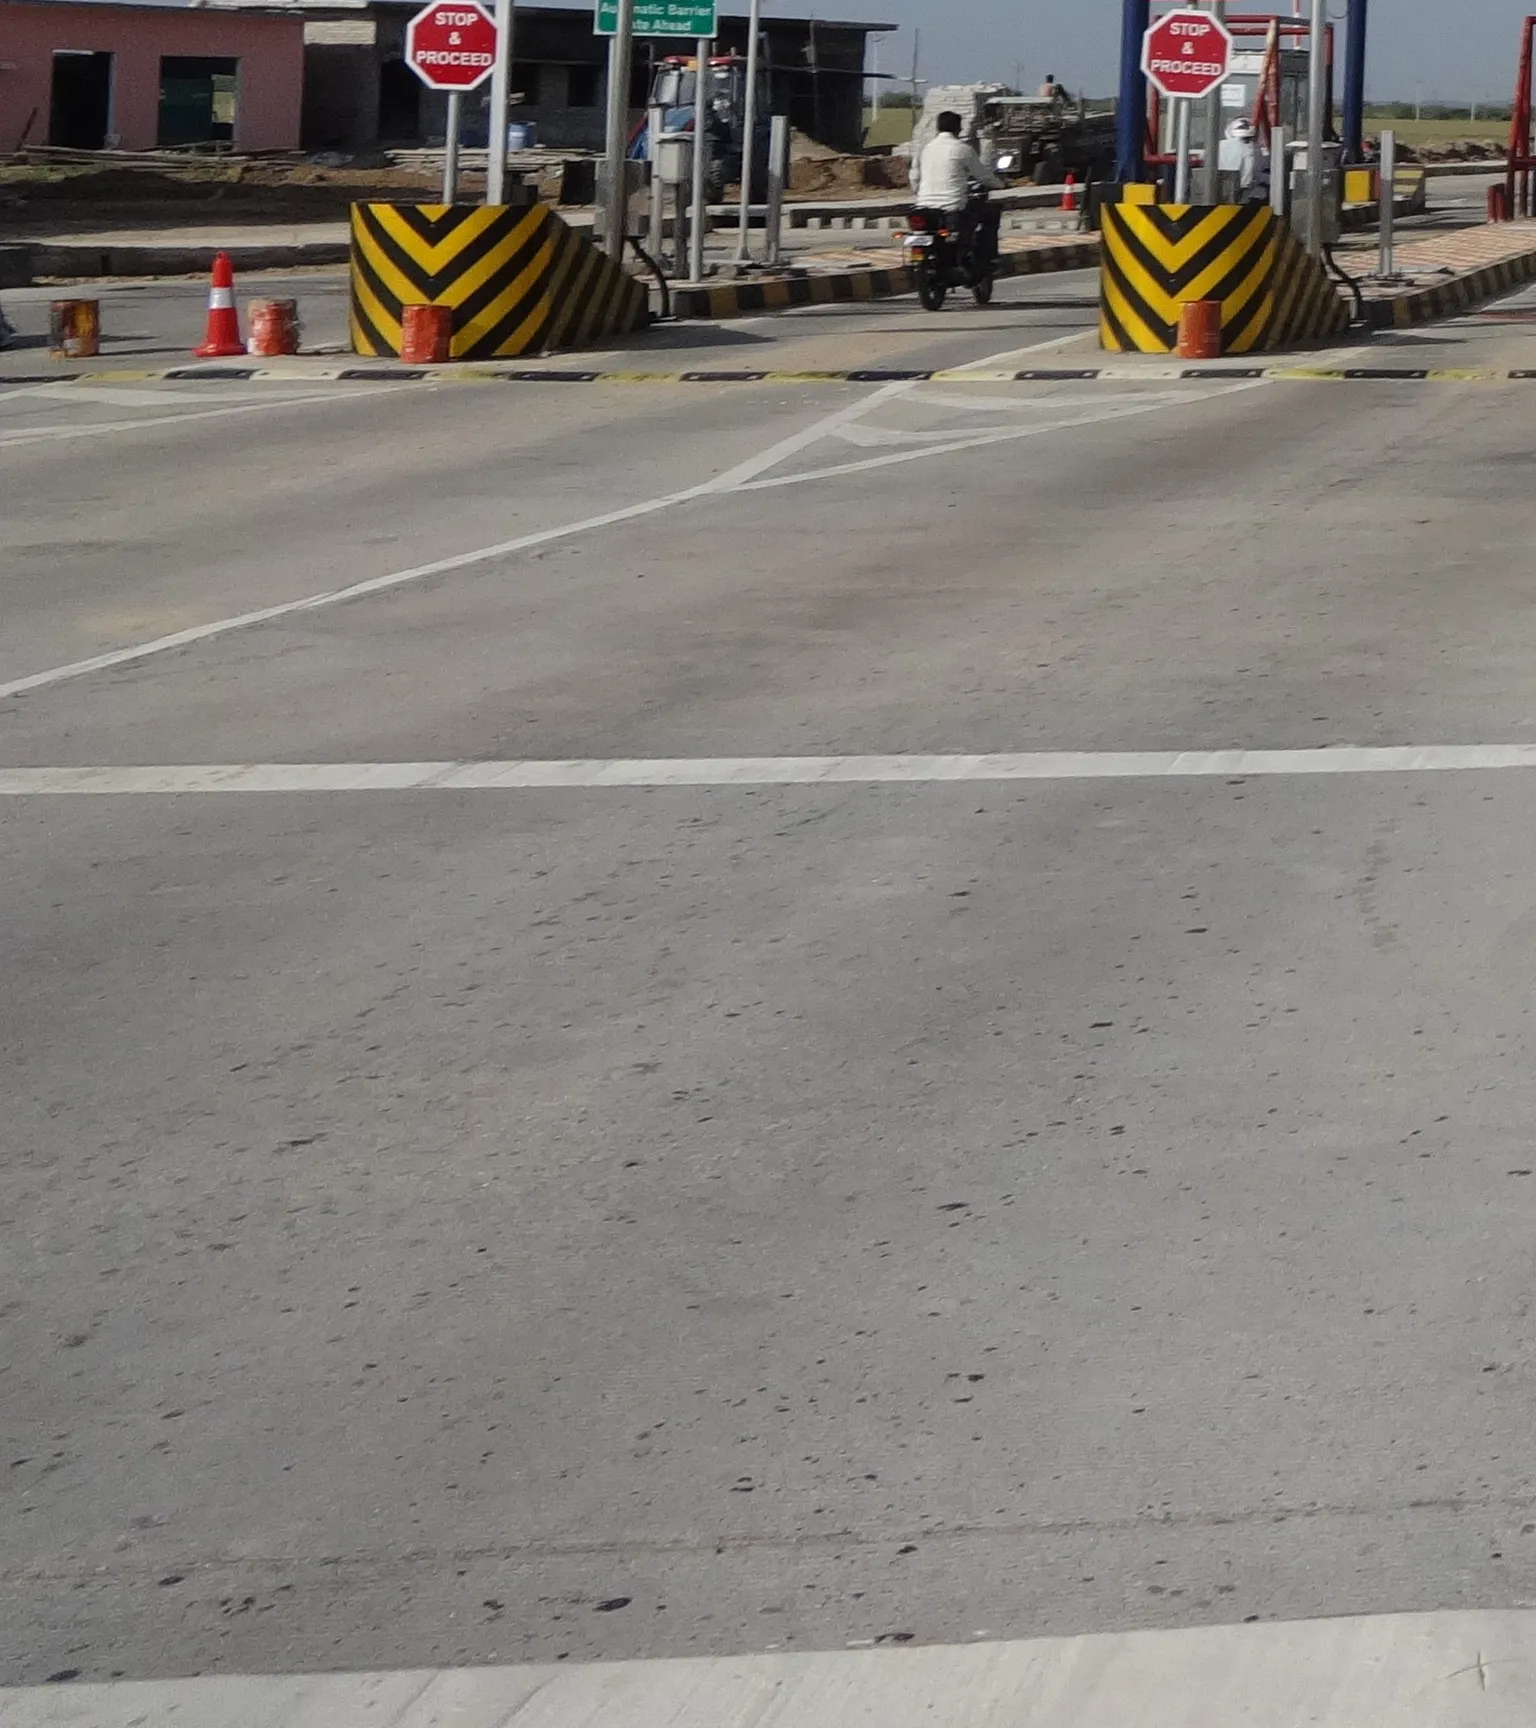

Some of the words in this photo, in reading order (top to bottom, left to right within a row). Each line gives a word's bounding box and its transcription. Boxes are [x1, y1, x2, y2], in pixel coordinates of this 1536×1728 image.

[668, 4, 711, 16] Barrier
[435, 12, 478, 26] STOP
[1169, 22, 1210, 36] STOP
[448, 31, 461, 45] &
[1181, 41, 1194, 54] &
[416, 50, 492, 66] PROCEED
[1150, 59, 1222, 76] PROCEED
